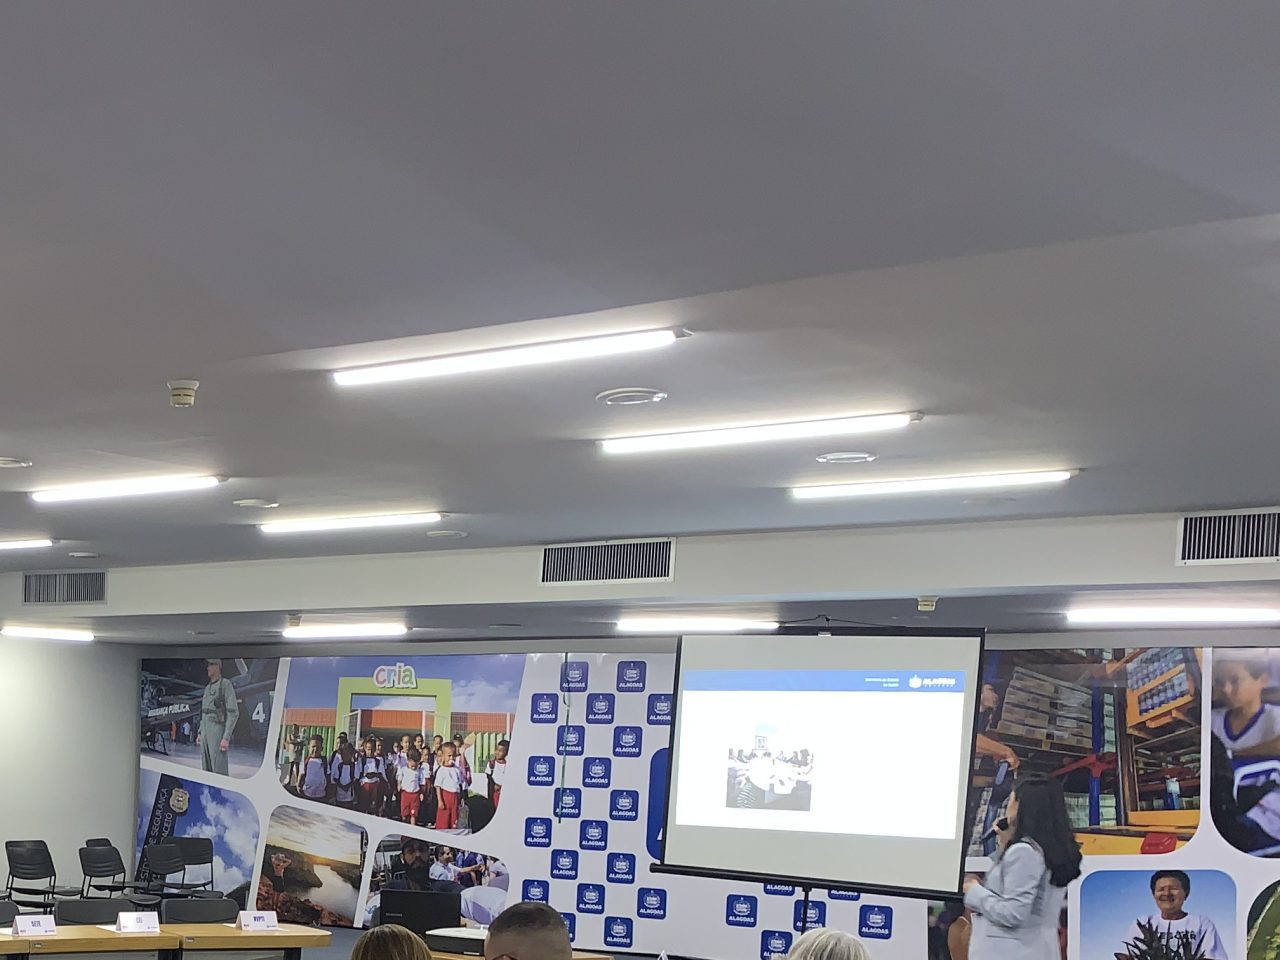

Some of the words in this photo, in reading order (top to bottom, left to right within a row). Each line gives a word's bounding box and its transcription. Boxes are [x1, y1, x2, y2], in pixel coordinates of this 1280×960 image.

[374, 663, 415, 687] cria
[252, 702, 266, 723] 4
[151, 788, 169, 836] SEGURANÇA
[728, 915, 754, 923] ALAGOAS
